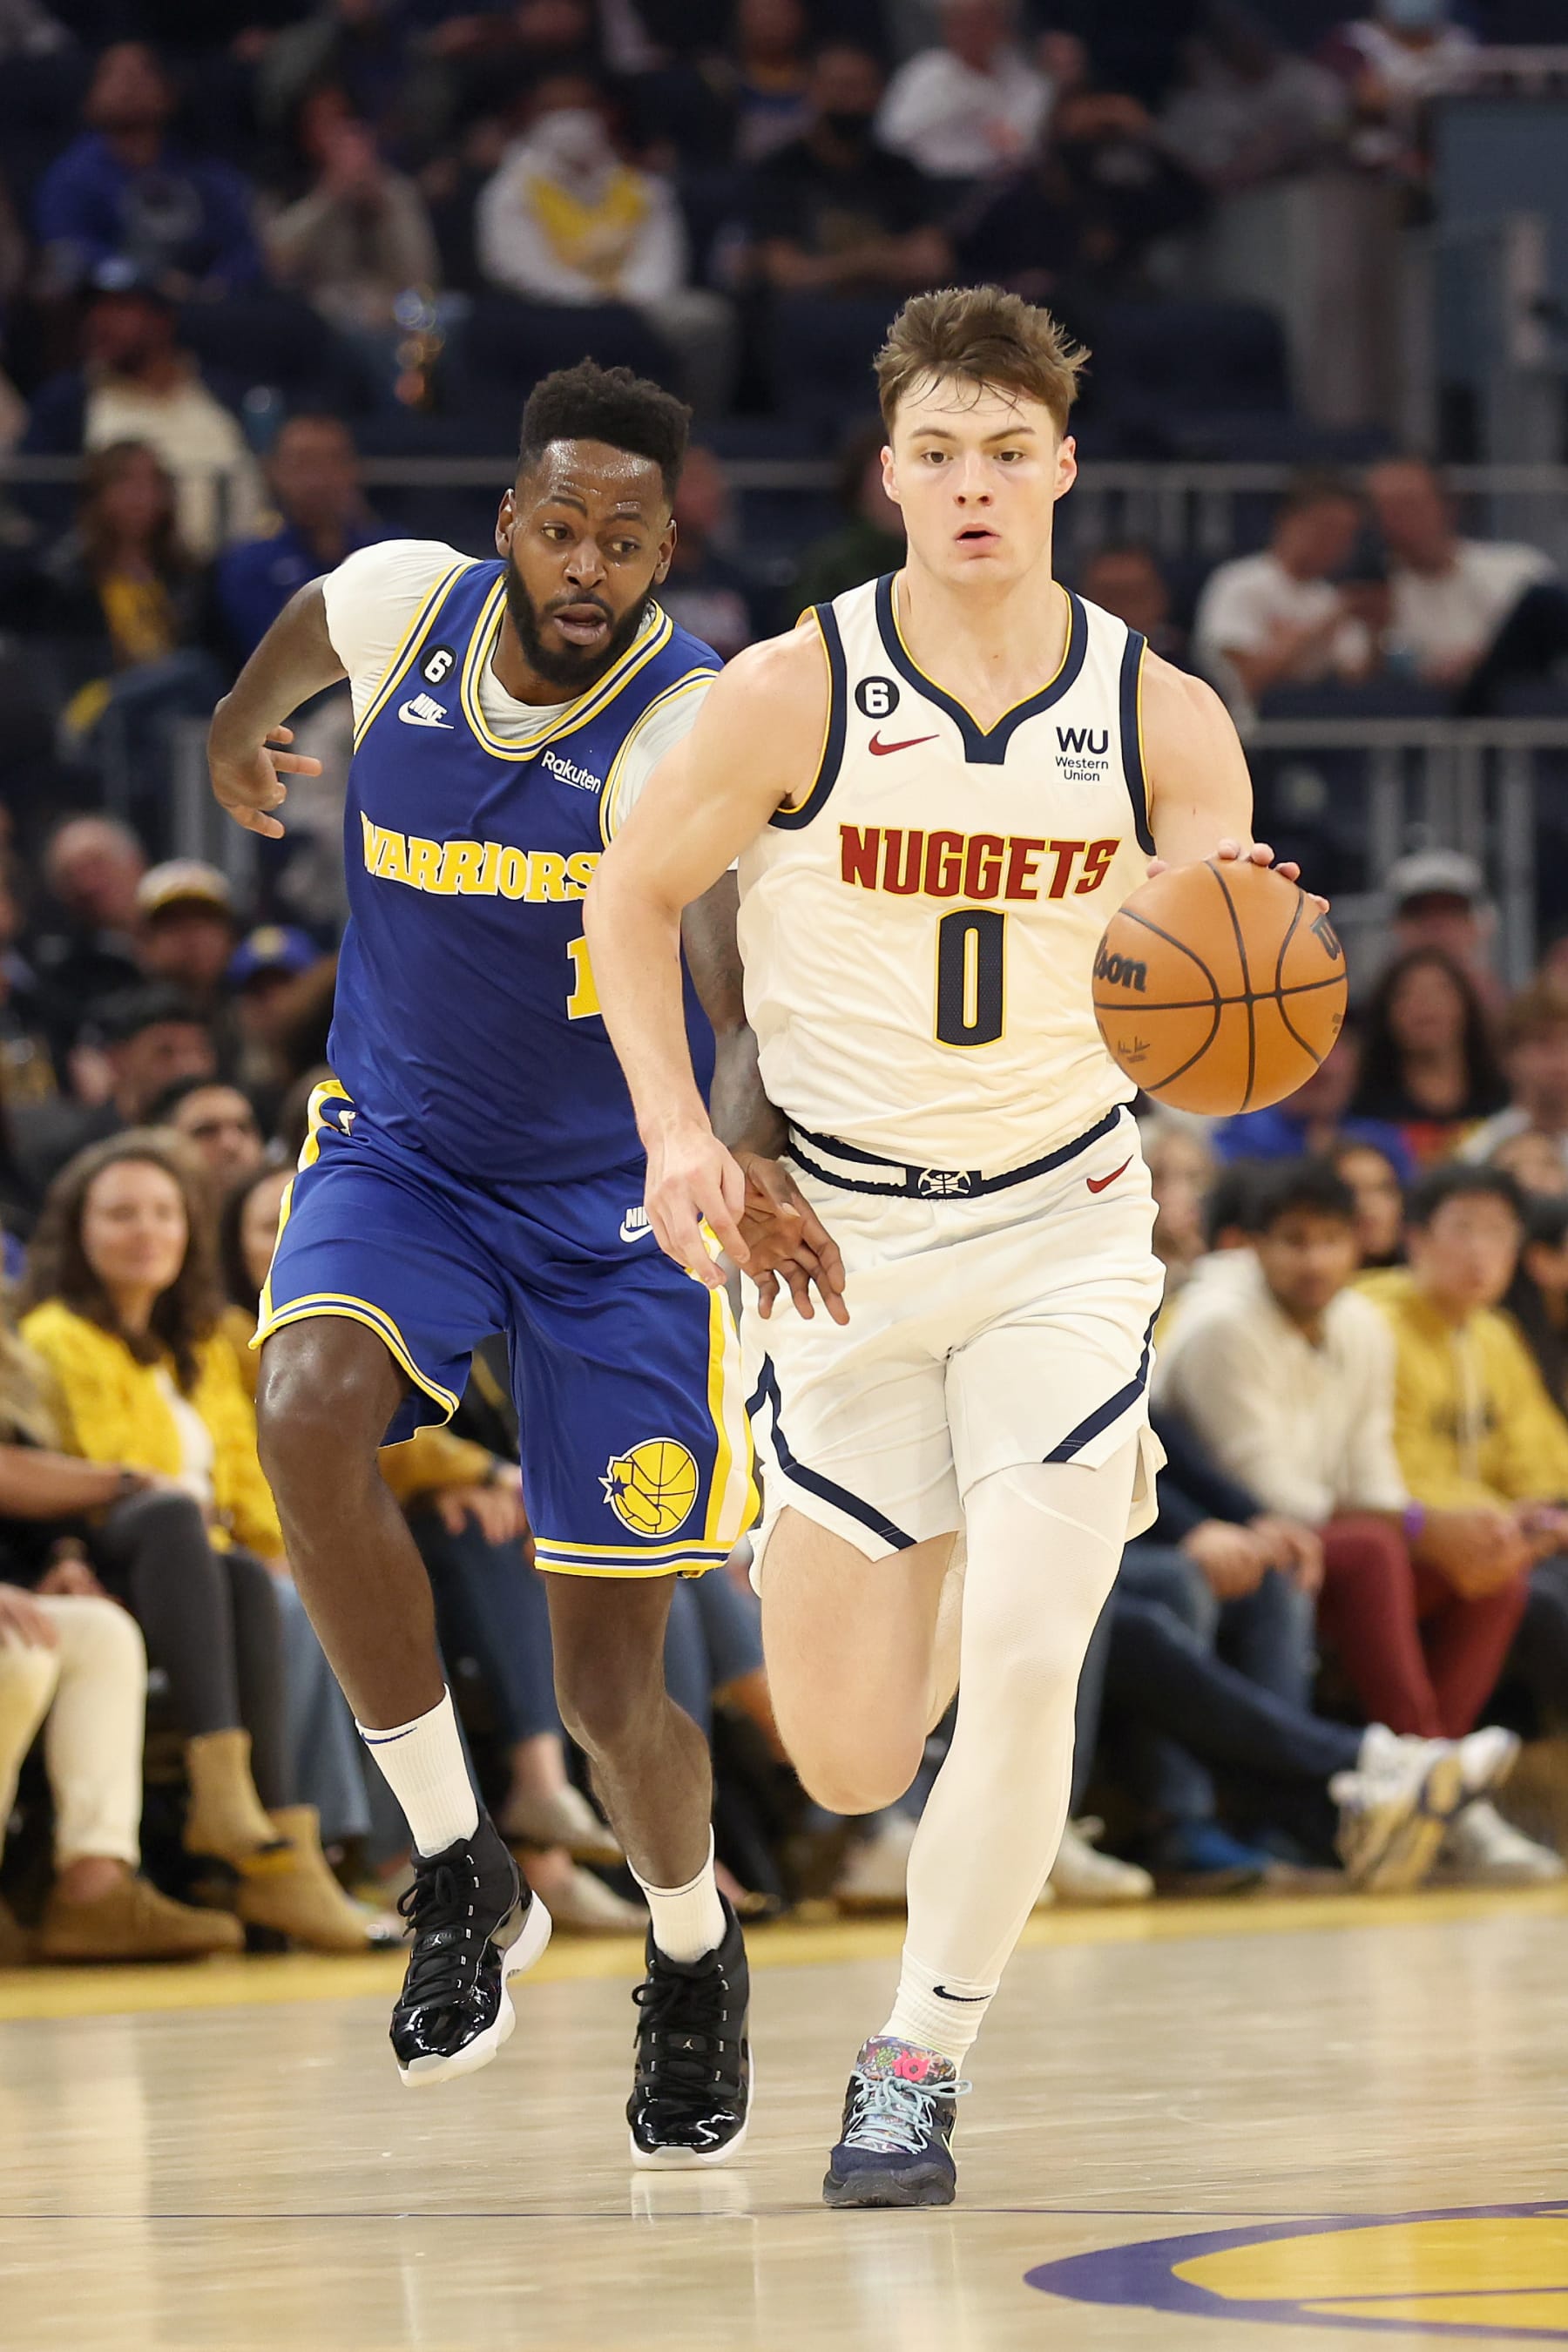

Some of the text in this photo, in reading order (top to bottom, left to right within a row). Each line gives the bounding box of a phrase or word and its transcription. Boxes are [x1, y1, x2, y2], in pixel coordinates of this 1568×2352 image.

[424, 650, 453, 683] 6
[409, 693, 448, 722] NIKE
[865, 681, 890, 714] 6
[1056, 726, 1109, 754] WU
[541, 750, 602, 794] Rakuten
[1055, 755, 1109, 769] Western
[1064, 769, 1100, 781] Union
[360, 810, 603, 903] WARRIORS
[838, 821, 1122, 902] NUGGETS
[933, 905, 1009, 1051] 0
